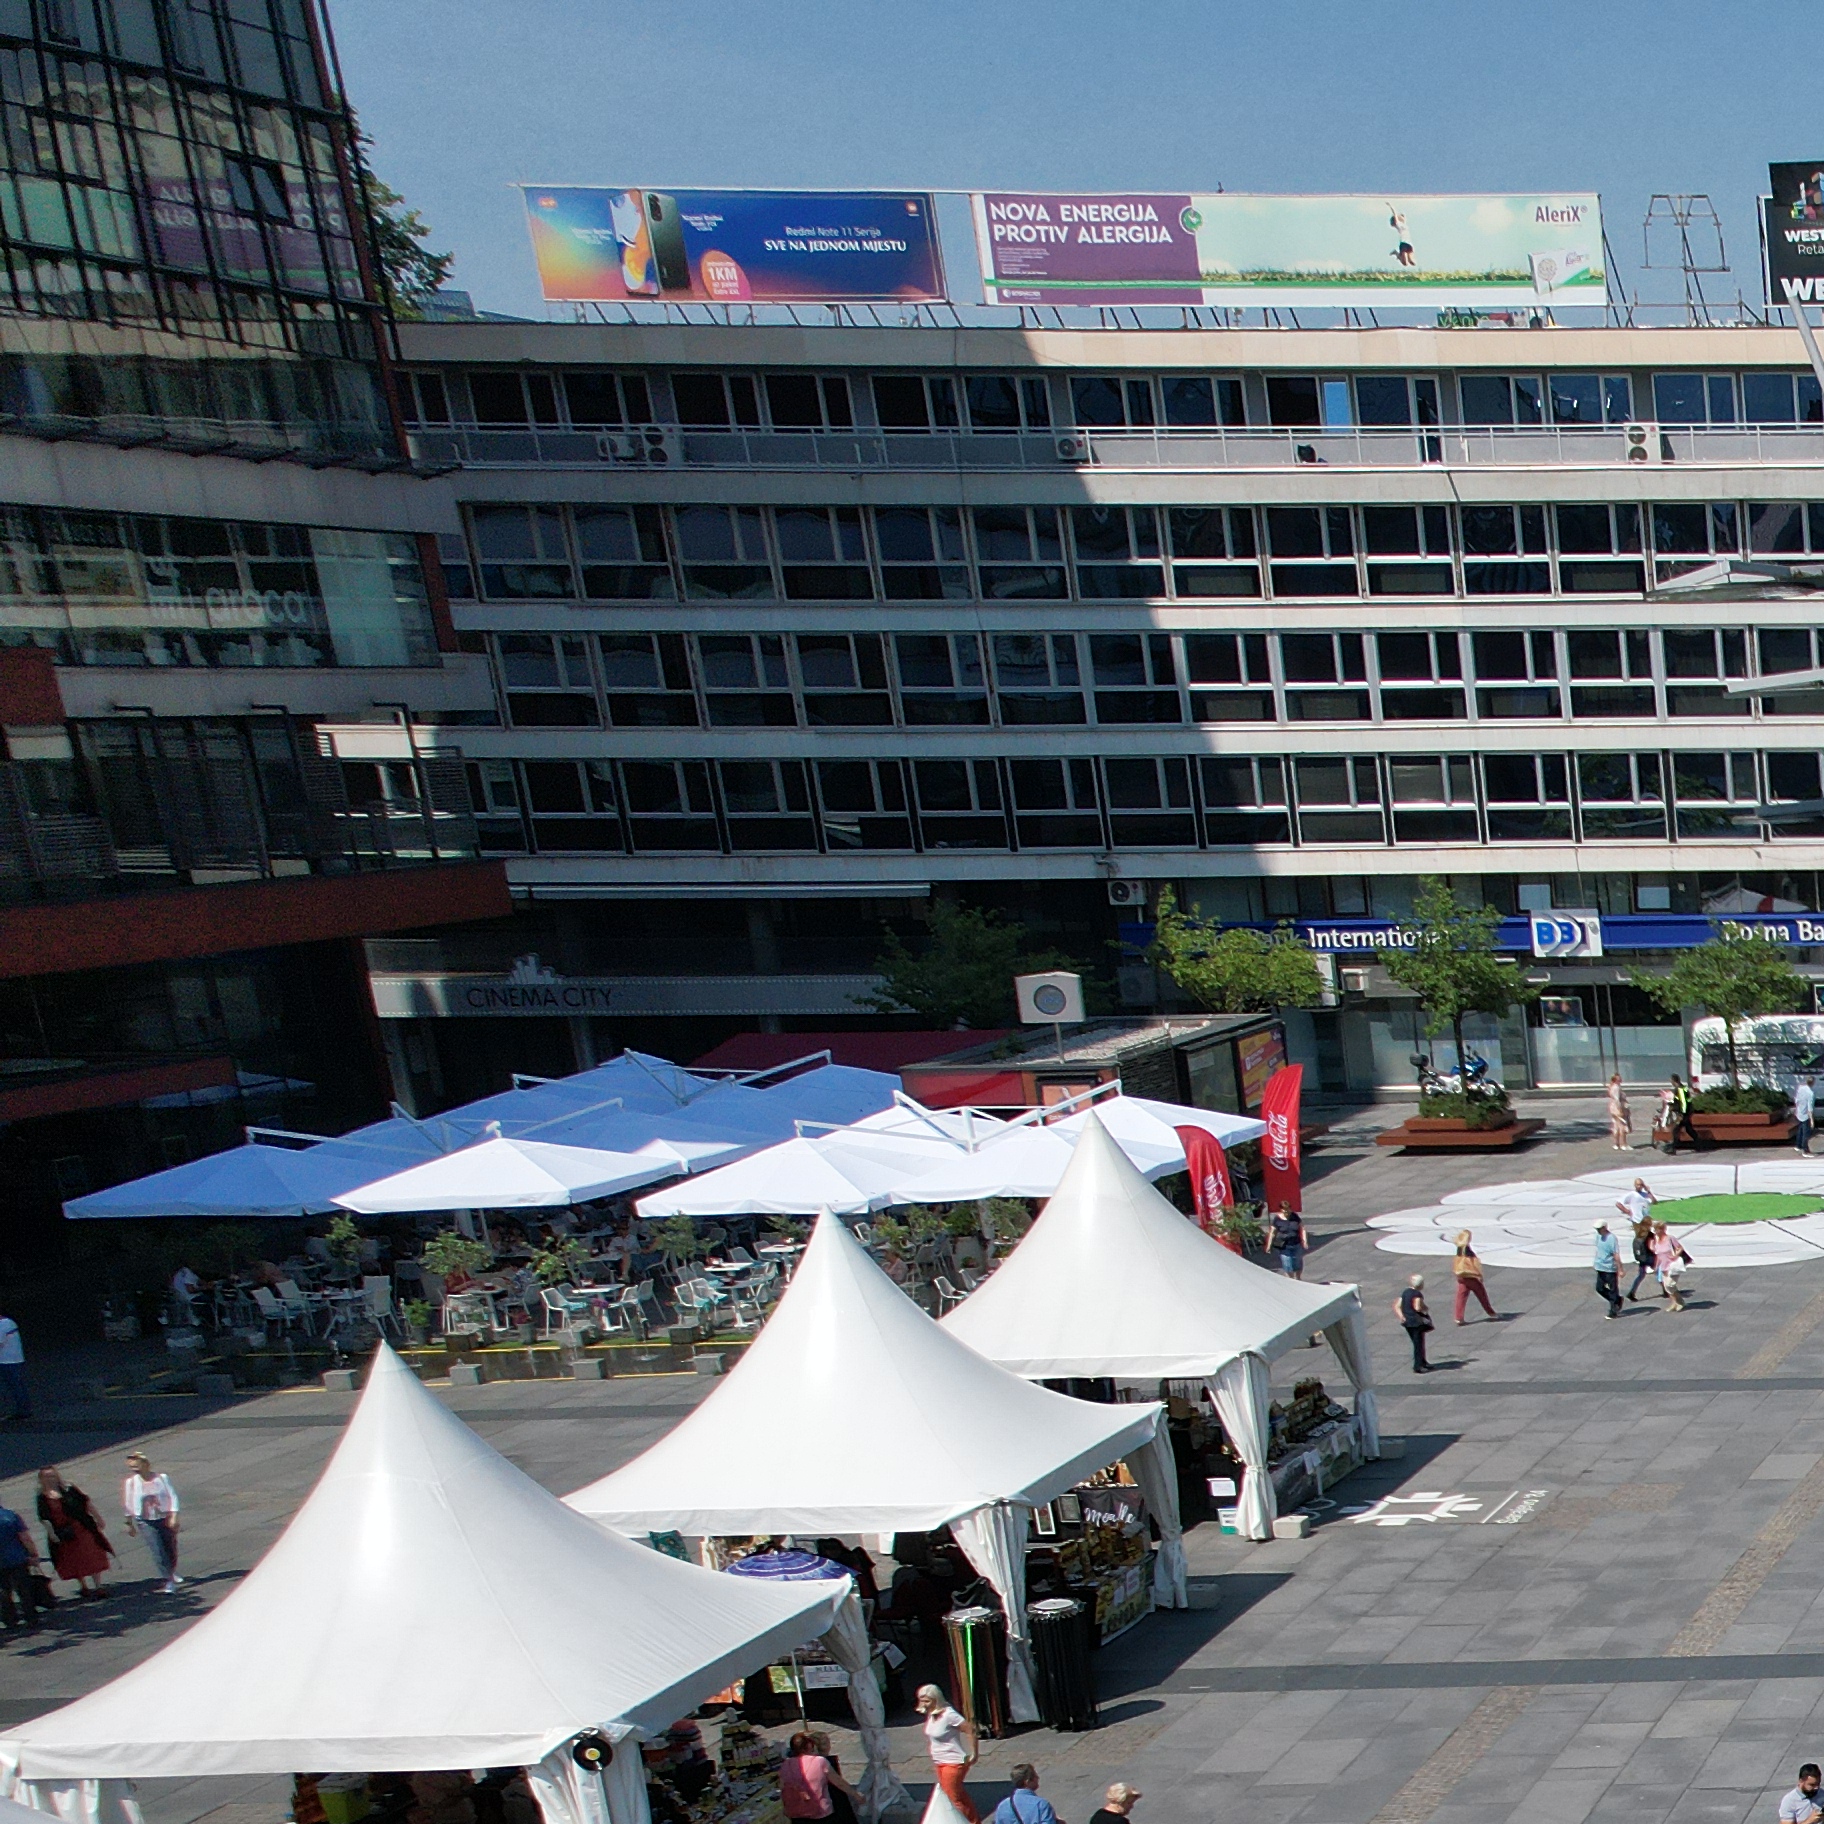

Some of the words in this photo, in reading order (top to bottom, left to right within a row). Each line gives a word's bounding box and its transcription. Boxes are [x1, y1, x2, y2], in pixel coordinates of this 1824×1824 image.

[990, 203, 1050, 222] NOVA
[1060, 204, 1158, 222] ENERGIJA
[993, 225, 1068, 243] PROTIV
[1077, 226, 1173, 243] ALERGIJA
[764, 240, 786, 252] SVE
[788, 240, 806, 252] NA
[808, 240, 859, 253] JEDNOM
[861, 240, 907, 253] MJESTU
[708, 267, 738, 281] 1KM
[466, 988, 559, 1008] CINEMA
[563, 987, 613, 1007] CITY
